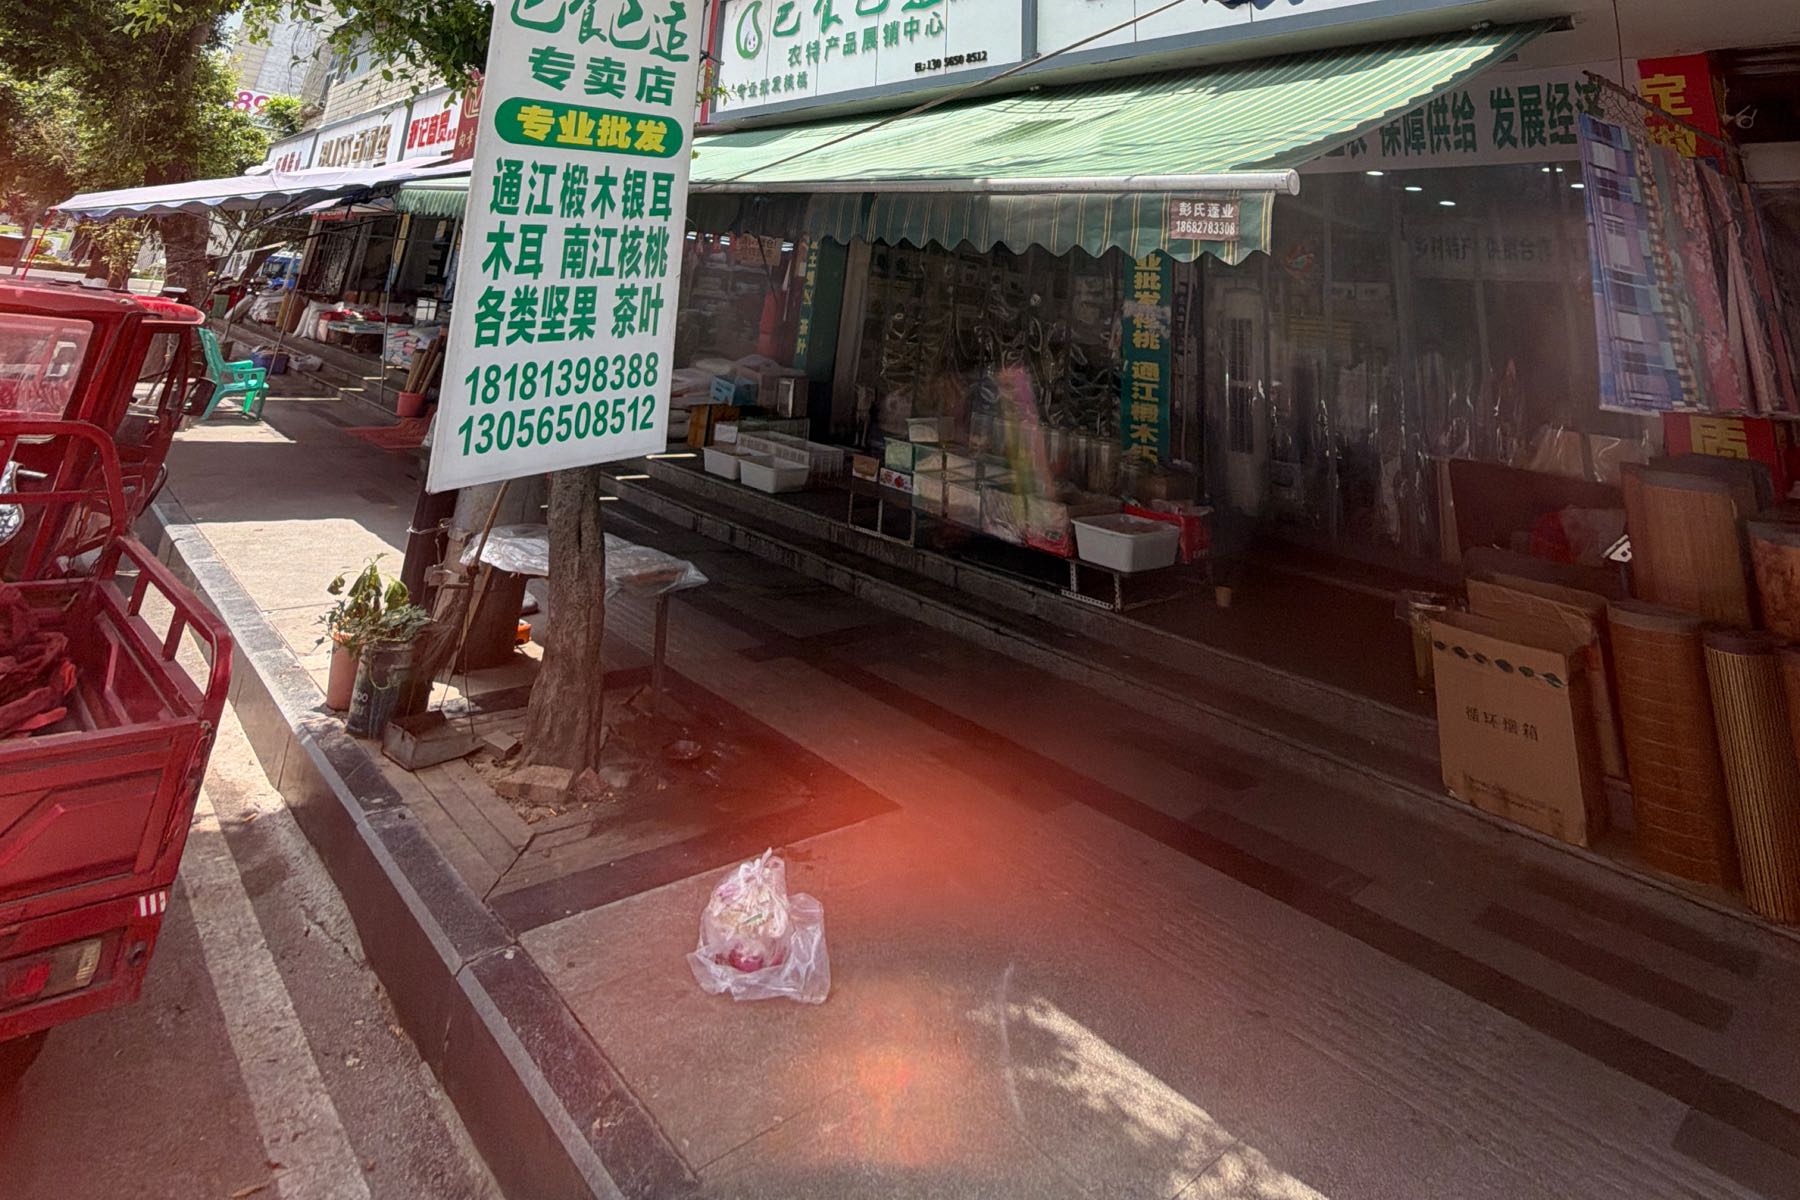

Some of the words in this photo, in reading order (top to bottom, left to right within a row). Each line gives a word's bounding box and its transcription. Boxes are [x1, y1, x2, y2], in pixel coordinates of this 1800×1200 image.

[787, 11, 945, 67] 农特产品展销中心
[528, 46, 676, 106] 专卖店
[517, 105, 669, 153] 专业批发
[489, 157, 675, 222] 通江椴木银耳
[482, 220, 548, 280] 木耳
[560, 223, 670, 280] 南江核桃
[474, 285, 598, 348] 各类坚果
[611, 283, 664, 339] 茶叶
[464, 352, 659, 406] 18181398388
[458, 394, 656, 456] 13056508512
